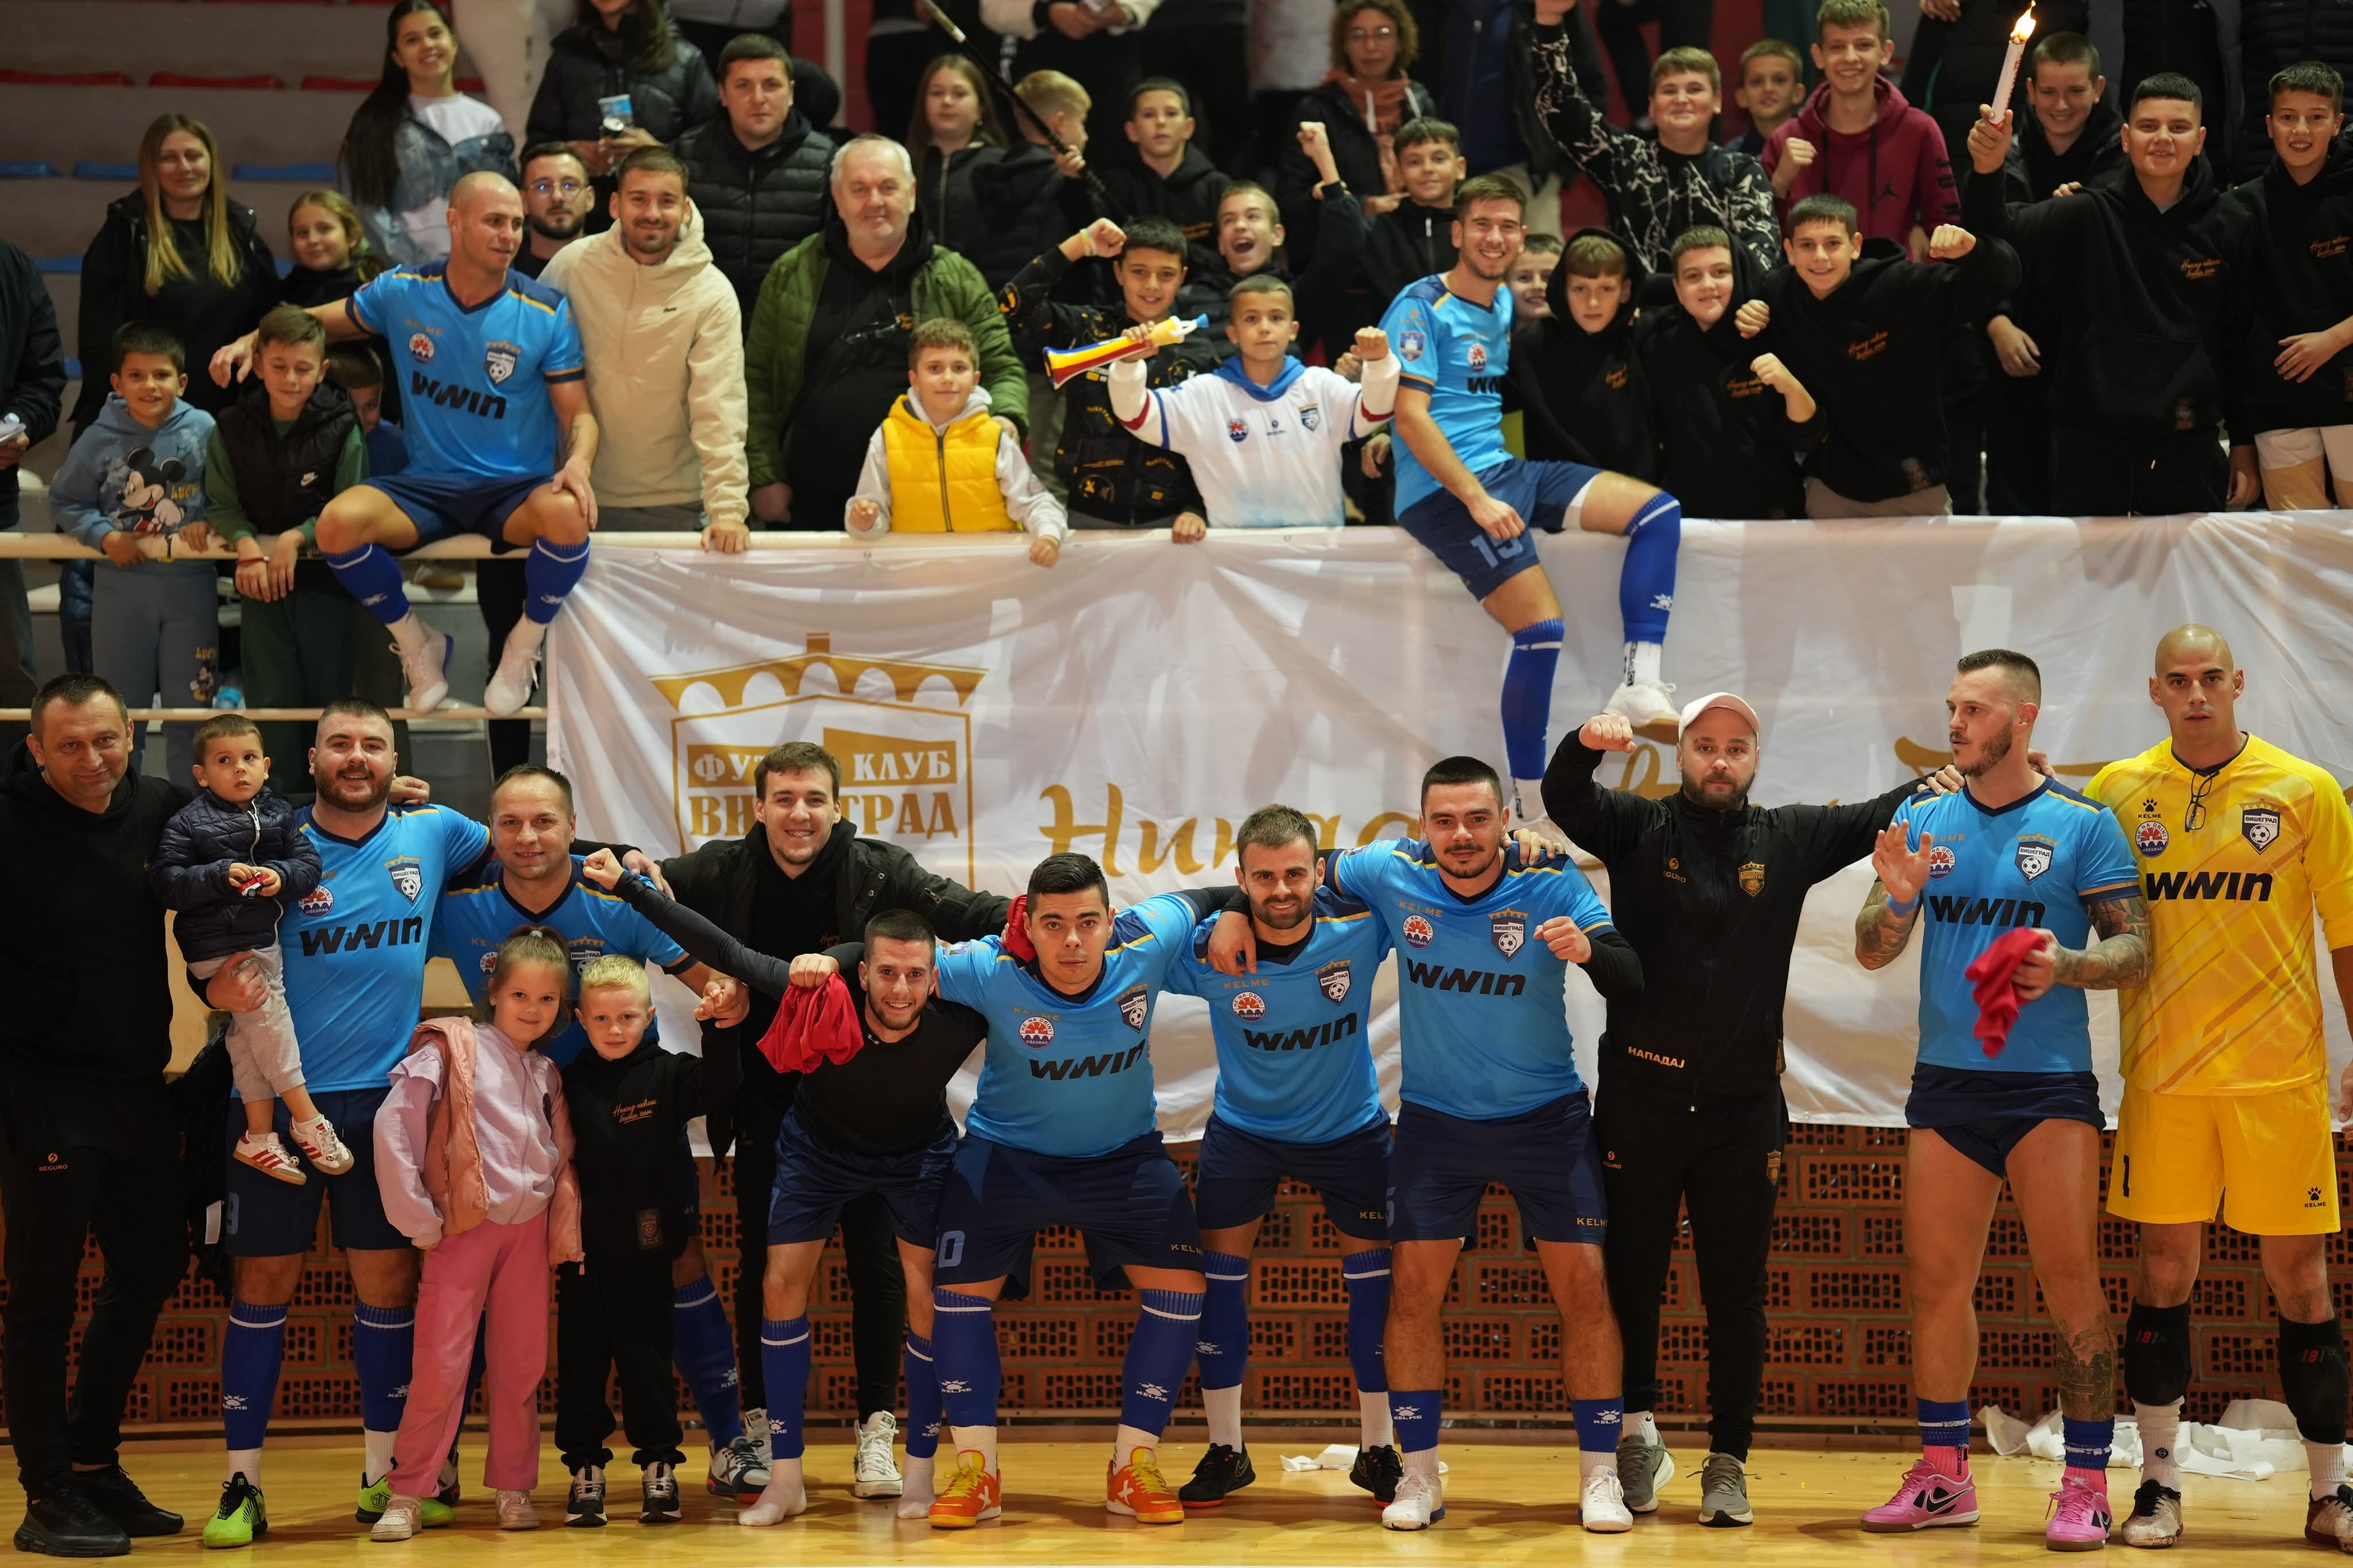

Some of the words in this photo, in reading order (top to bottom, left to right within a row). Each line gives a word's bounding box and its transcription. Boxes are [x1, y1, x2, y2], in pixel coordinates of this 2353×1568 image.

[1470, 534, 1523, 569] 15
[853, 750, 951, 782] КЛУБ
[2245, 816, 2277, 824] ВИШЕГРАД
[2153, 822, 2167, 837] DRINI
[1931, 834, 1966, 842] ELME
[2020, 848, 2050, 857] ВИШЕГРАД
[393, 870, 419, 878] ВИШЕГРАД
[1399, 900, 1443, 917] KELME
[1420, 917, 1432, 934] DRINI
[1224, 979, 1269, 989] KELME
[1321, 973, 1348, 984] ВИШЕГРАД
[1122, 997, 1146, 1011] ВИШЕГРАД
[1233, 998, 1240, 1007] HE
[1249, 993, 1263, 1006] DRINI
[1021, 1023, 1027, 1032] HE
[1040, 1018, 1053, 1032] DRINI
[1628, 1046, 1685, 1069] НАПАДАЈ
[38, 1164, 68, 1172] SEGURO
[2123, 1153, 2130, 1198] 1
[1360, 1211, 1384, 1220] KEL
[1576, 1217, 1608, 1227] KELM
[1170, 1243, 1203, 1256] KELM
[1135, 1389, 1168, 1402] KELME
